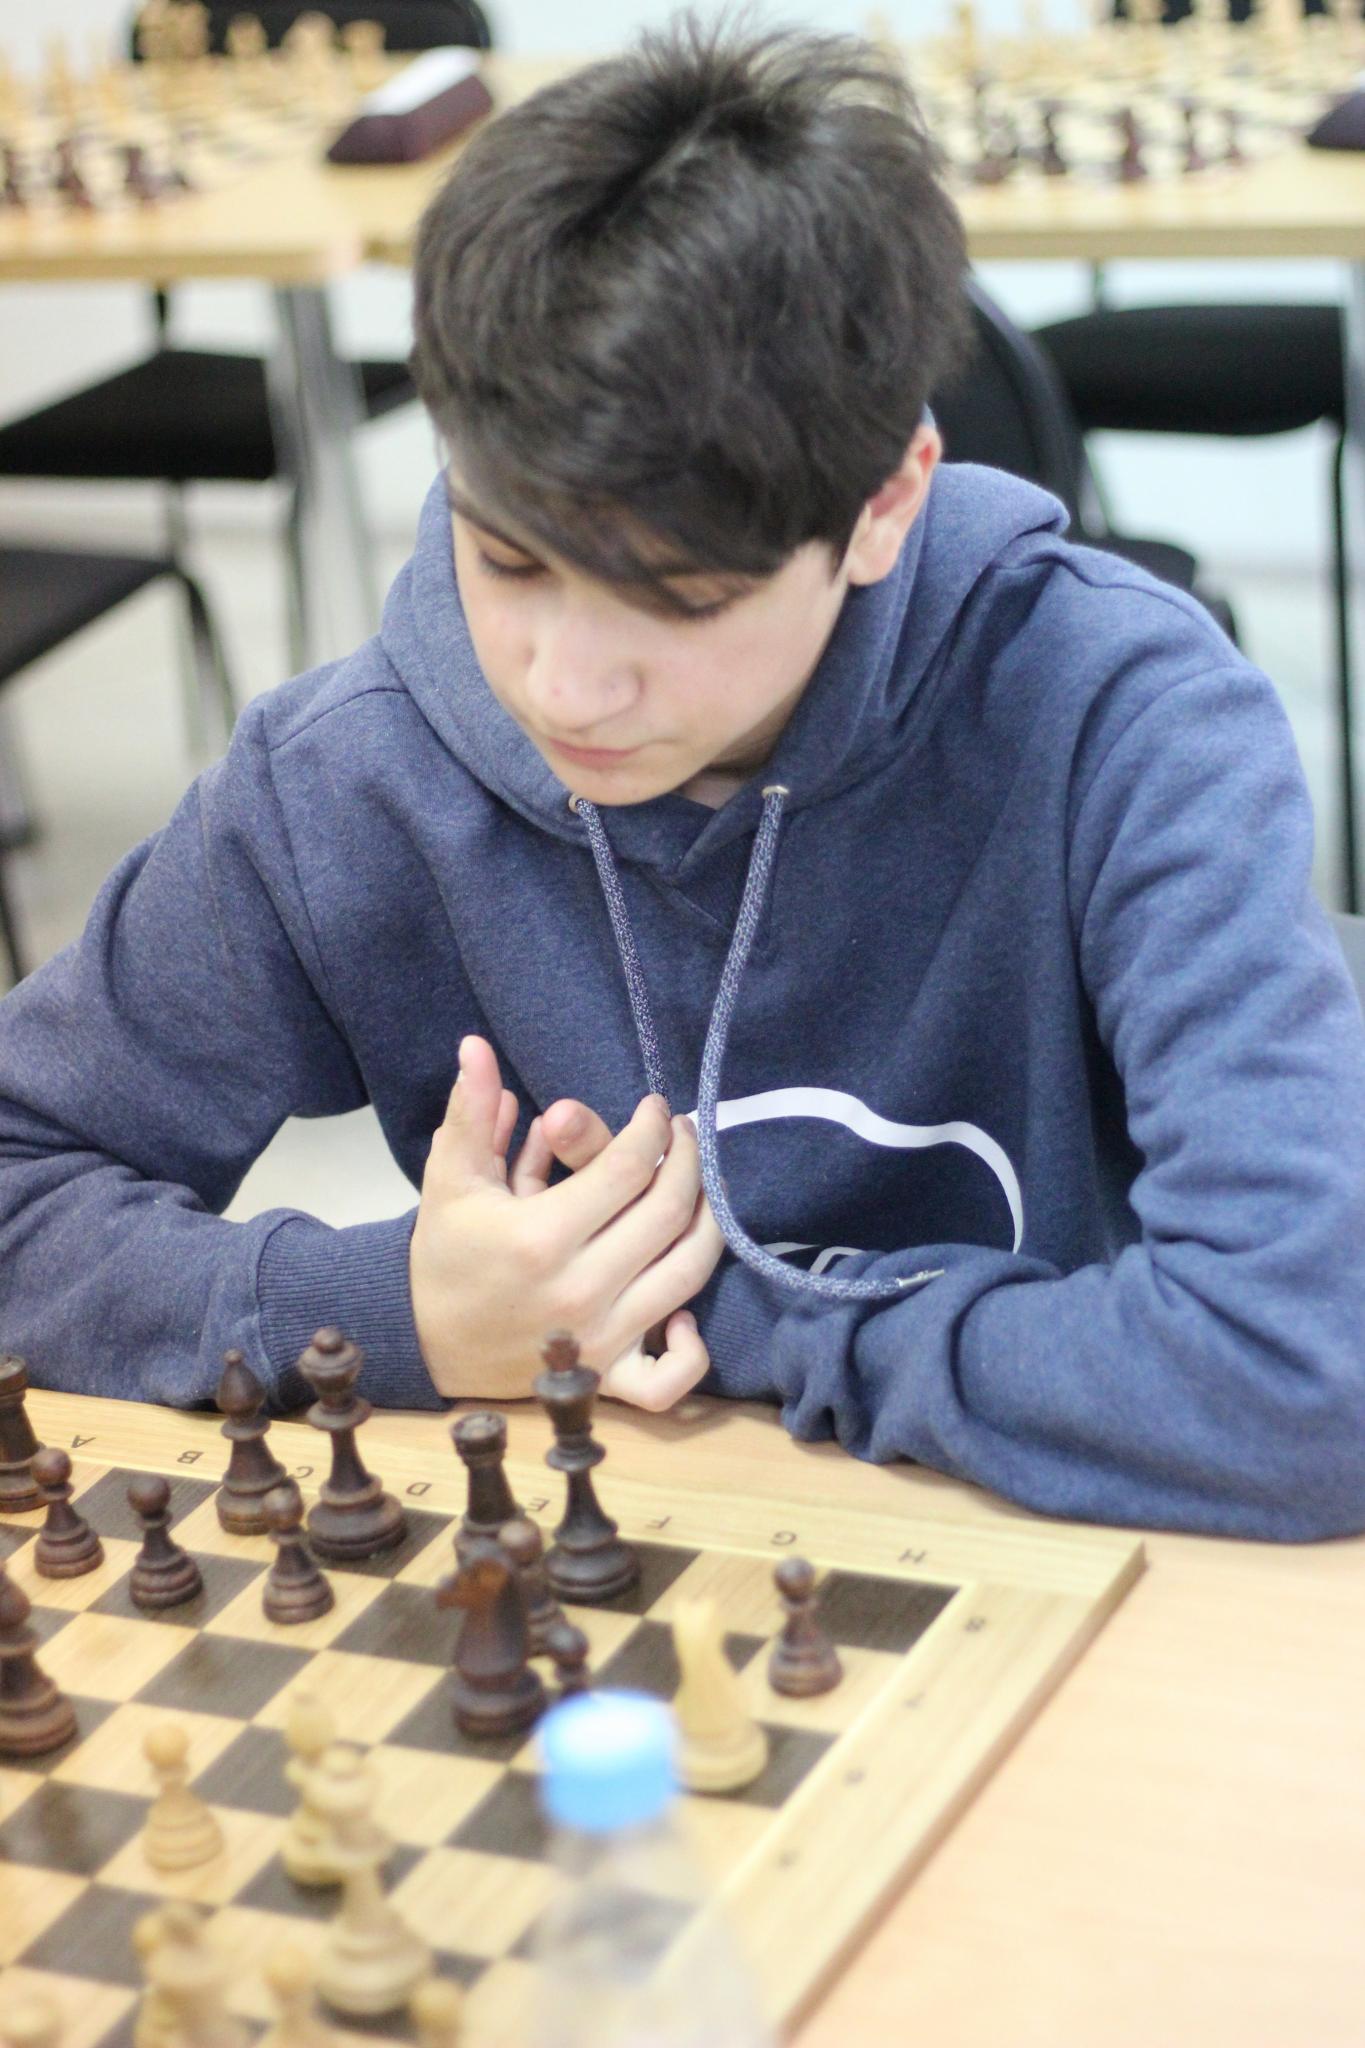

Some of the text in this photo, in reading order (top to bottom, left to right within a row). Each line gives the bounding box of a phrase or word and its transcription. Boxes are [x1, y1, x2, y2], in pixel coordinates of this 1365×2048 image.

[71, 1434, 97, 1449] A
[176, 1450, 204, 1465] B
[290, 1465, 314, 1480] C
[406, 1482, 432, 1497] D
[770, 1530, 798, 1547] G
[898, 1547, 926, 1564] H
